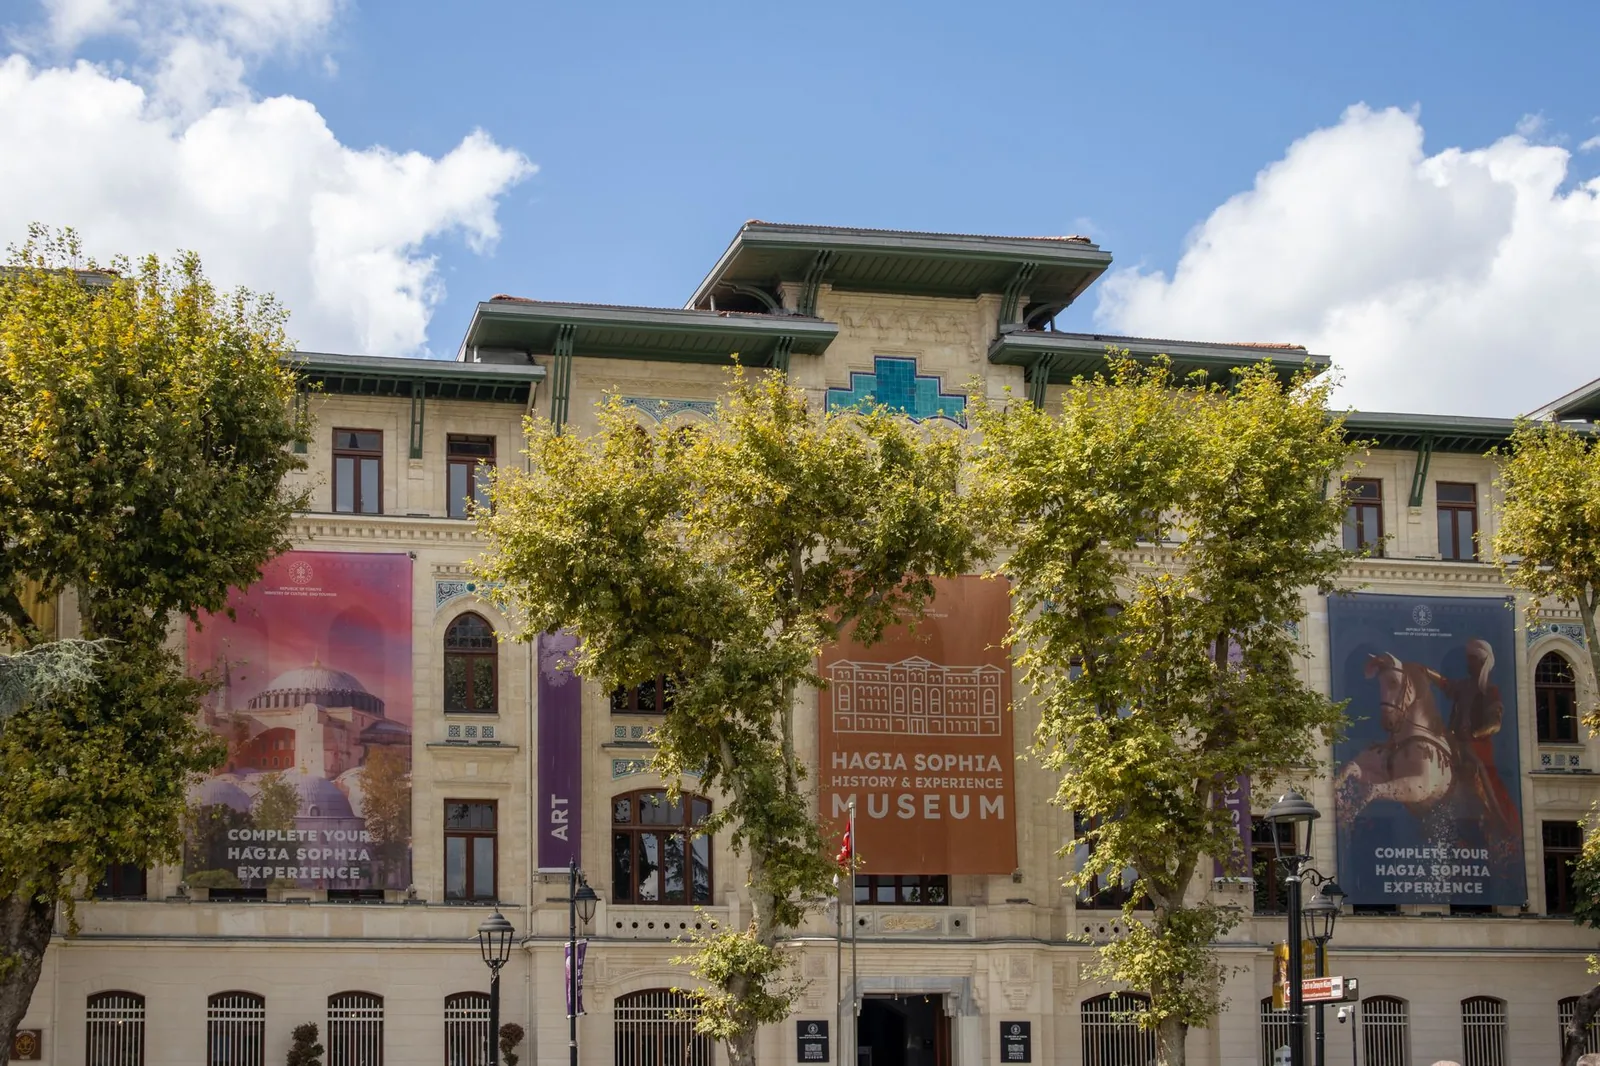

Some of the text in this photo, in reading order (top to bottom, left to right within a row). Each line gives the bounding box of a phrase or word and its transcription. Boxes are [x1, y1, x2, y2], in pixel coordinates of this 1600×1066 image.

[832, 752, 1002, 772] HAGIA SOPHIA
[832, 776, 1003, 789] HISTORY & EXPERIENCE
[832, 793, 1005, 820] MUSEUM
[551, 793, 569, 842] ART
[227, 829, 370, 842] COMPLETE YOUR
[227, 847, 371, 861] HAGIA SOPHIA
[1375, 847, 1489, 860] COMPLETE YOUR
[237, 866, 360, 879] EXPERIENCE
[1375, 864, 1491, 877] HAGIA SOPHIA
[1383, 882, 1483, 894] EXPERIENCE
